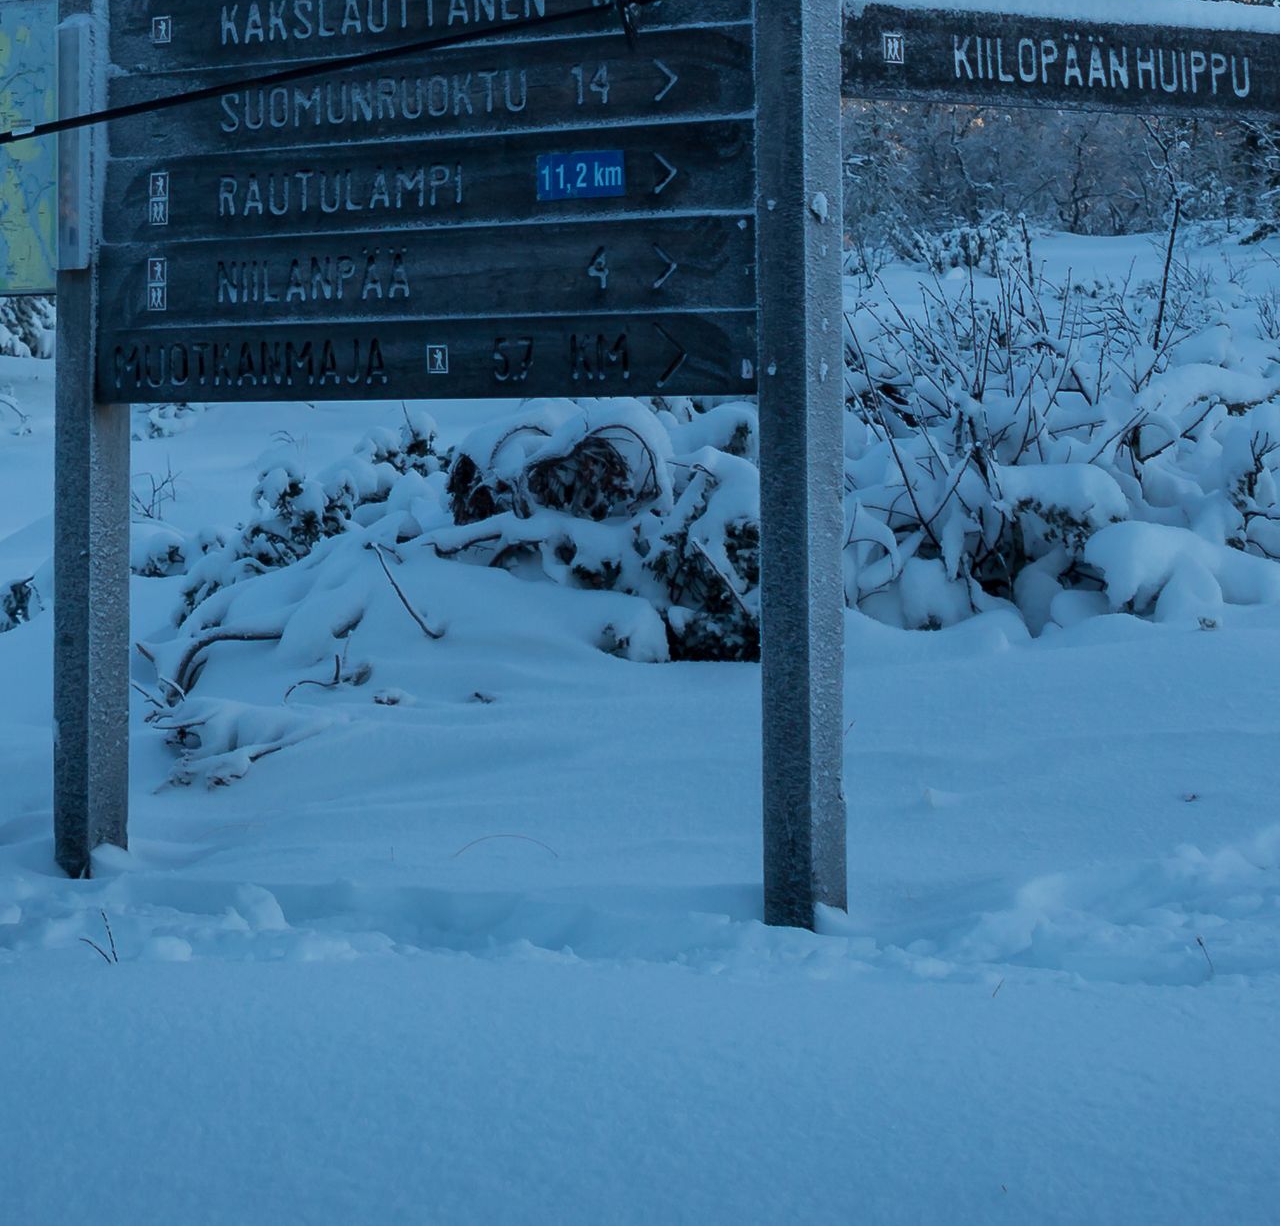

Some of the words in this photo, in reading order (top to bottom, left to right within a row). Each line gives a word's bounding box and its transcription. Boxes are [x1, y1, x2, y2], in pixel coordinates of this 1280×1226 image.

[953, 34, 1250, 98] KIILOPÄÄNHUIPPU
[220, 69, 528, 133] SUOMUNRUOKTU
[571, 65, 610, 105] 14
[219, 162, 464, 218] RAUTULAMPI
[541, 162, 587, 194] 11,2
[594, 161, 623, 187] km
[217, 247, 411, 304] NIILANPÄÄ
[587, 246, 609, 289] 4
[114, 337, 388, 389] MUOTKANMAJA
[571, 333, 631, 380] KM
